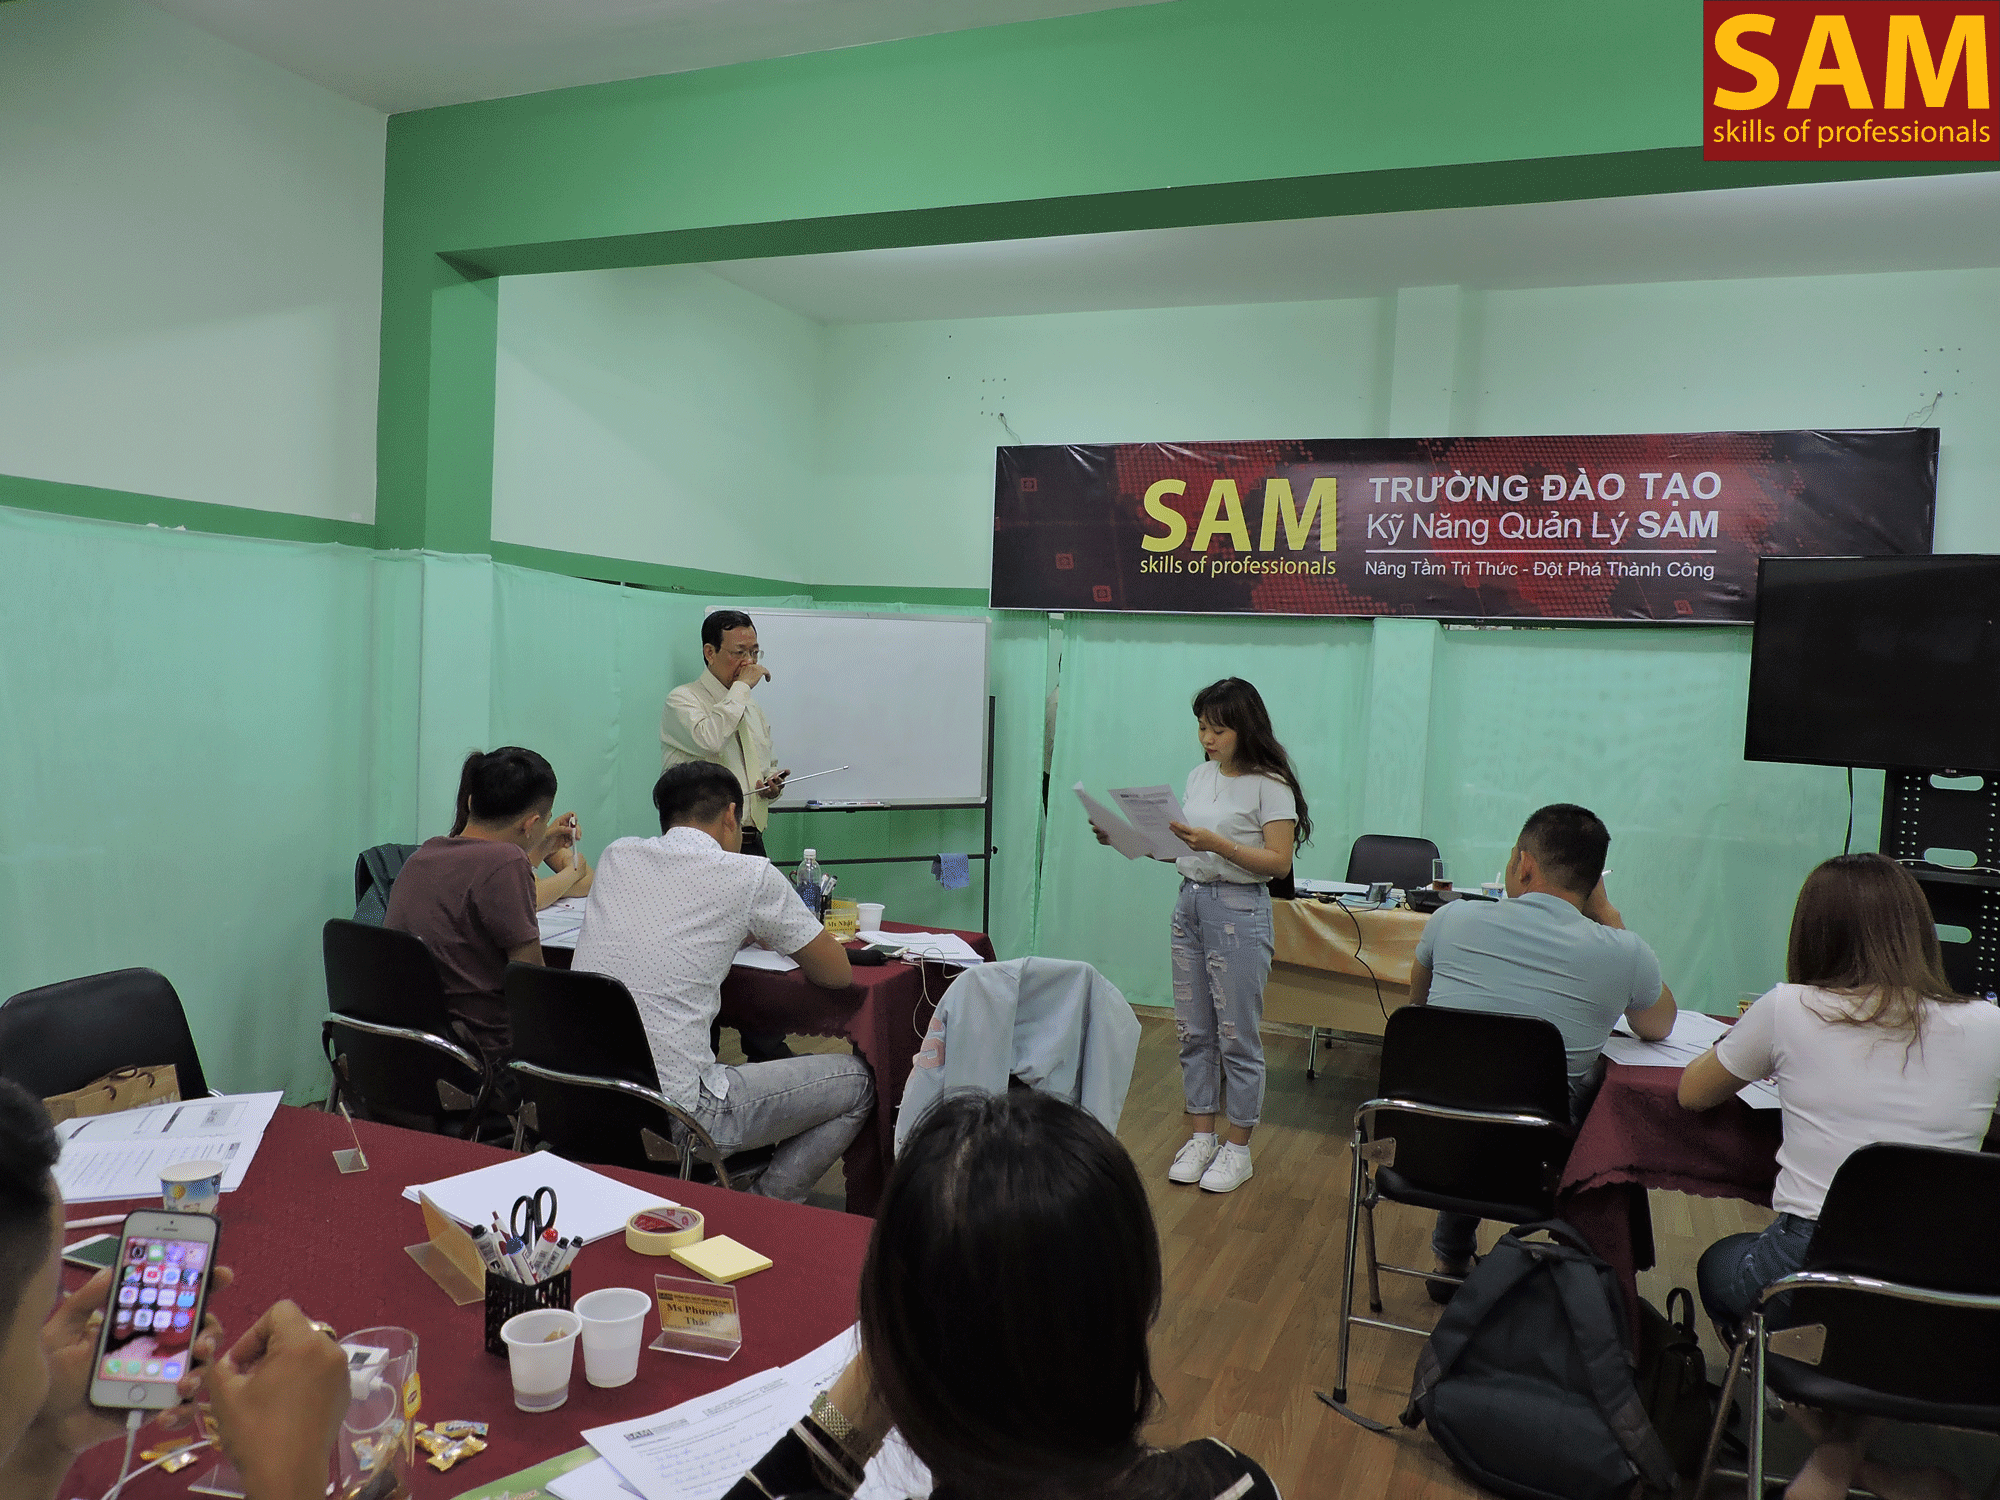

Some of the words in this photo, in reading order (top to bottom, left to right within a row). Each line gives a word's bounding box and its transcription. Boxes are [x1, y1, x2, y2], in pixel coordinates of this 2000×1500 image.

[1368, 469, 1529, 503] TRƯỜNG
[1541, 467, 1626, 501] ĐÀO
[1639, 471, 1722, 507] TẠO
[1141, 477, 1337, 552] SAM
[1367, 513, 1405, 546] Kỹ
[1412, 512, 1490, 546] Năng
[1499, 510, 1582, 540] Quản
[1592, 511, 1630, 546] Lý
[1637, 510, 1719, 539] SAM
[1140, 555, 1183, 574] skills
[1187, 555, 1208, 574] of
[1211, 555, 1337, 578] professionals
[1365, 560, 1407, 579] Nâng
[1411, 558, 1446, 576] Tầm
[1450, 560, 1471, 576] Tri
[1475, 561, 1519, 576] Thức
[1533, 561, 1563, 579] Đột
[1568, 561, 1602, 577] Phá
[1606, 561, 1661, 577] Thành
[1667, 561, 1715, 581] Công
